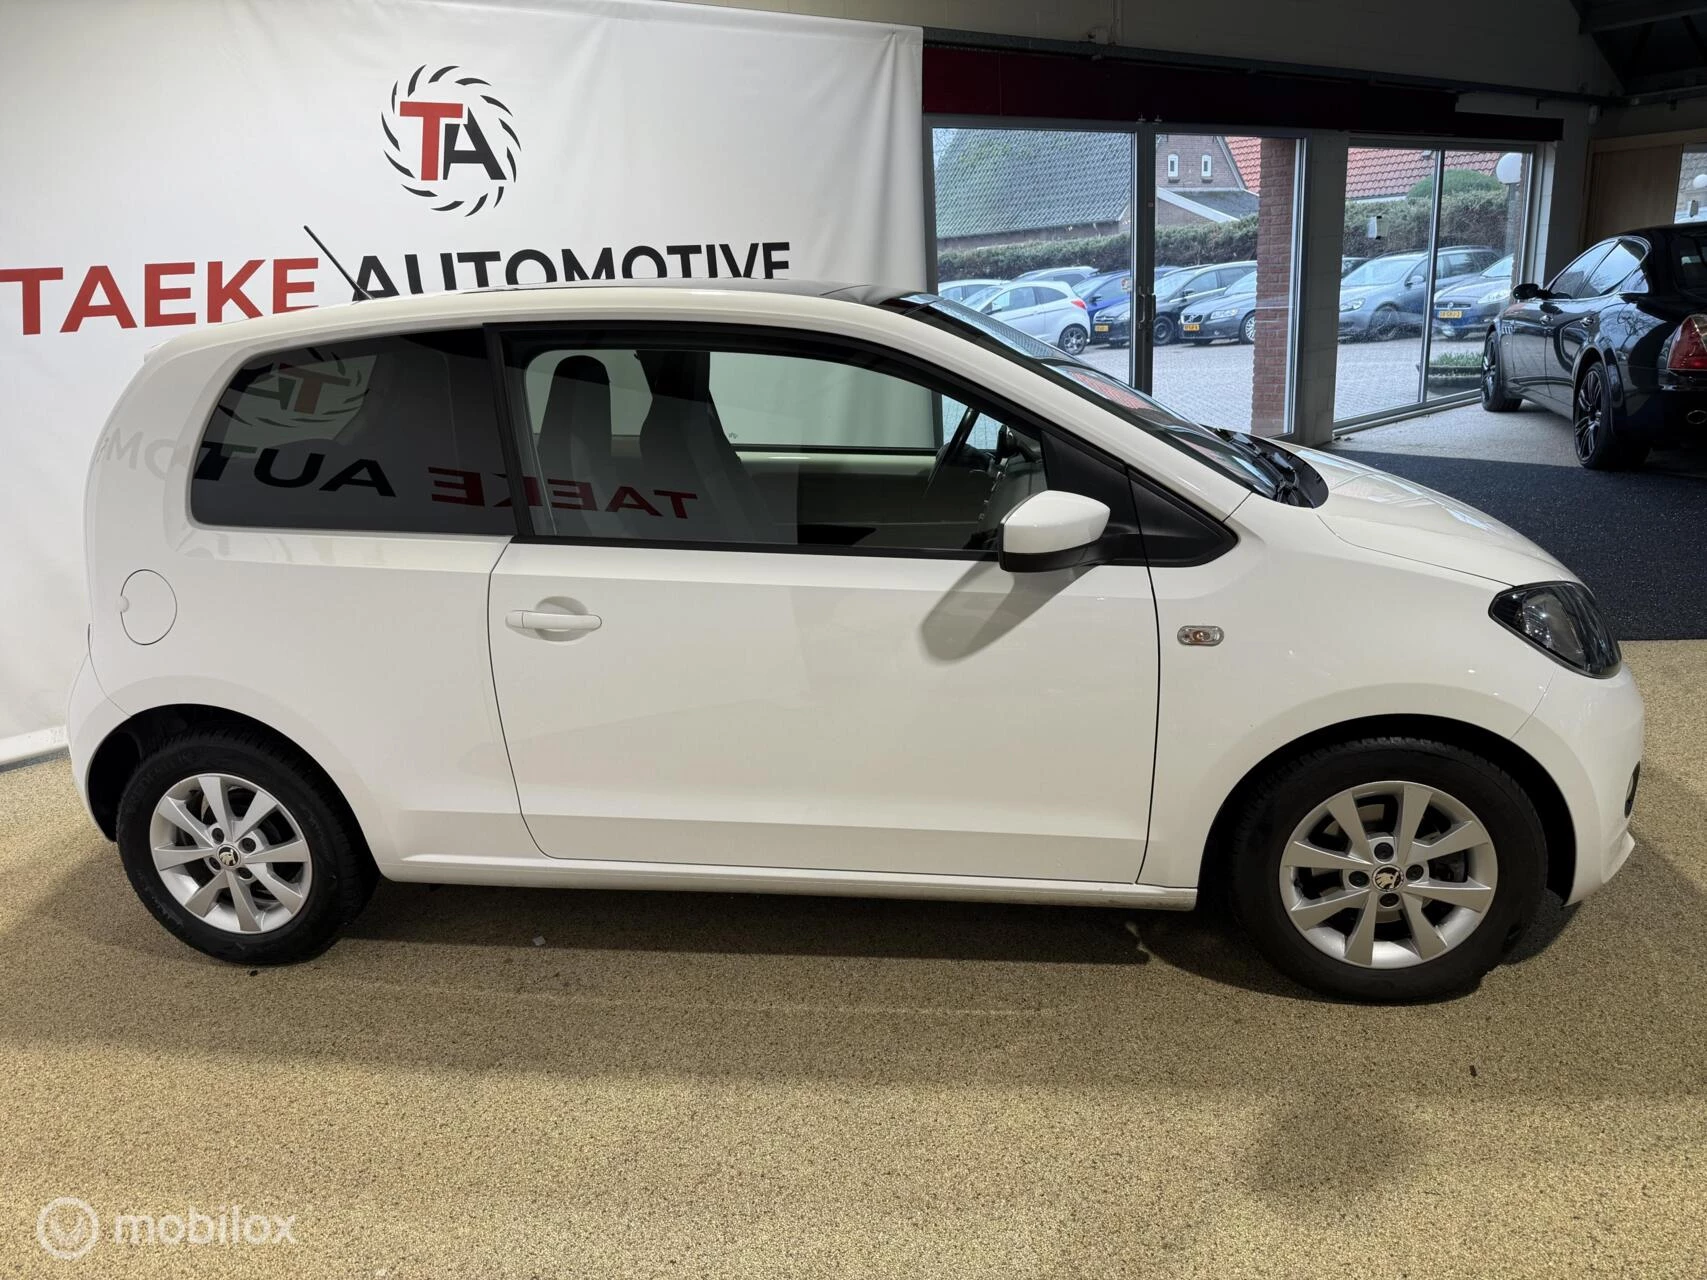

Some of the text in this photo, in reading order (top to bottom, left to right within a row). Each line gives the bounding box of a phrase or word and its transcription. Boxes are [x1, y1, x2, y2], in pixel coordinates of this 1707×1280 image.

[399, 101, 507, 181] TA
[0, 241, 790, 335] TAEKE AUTOMOTIVE
